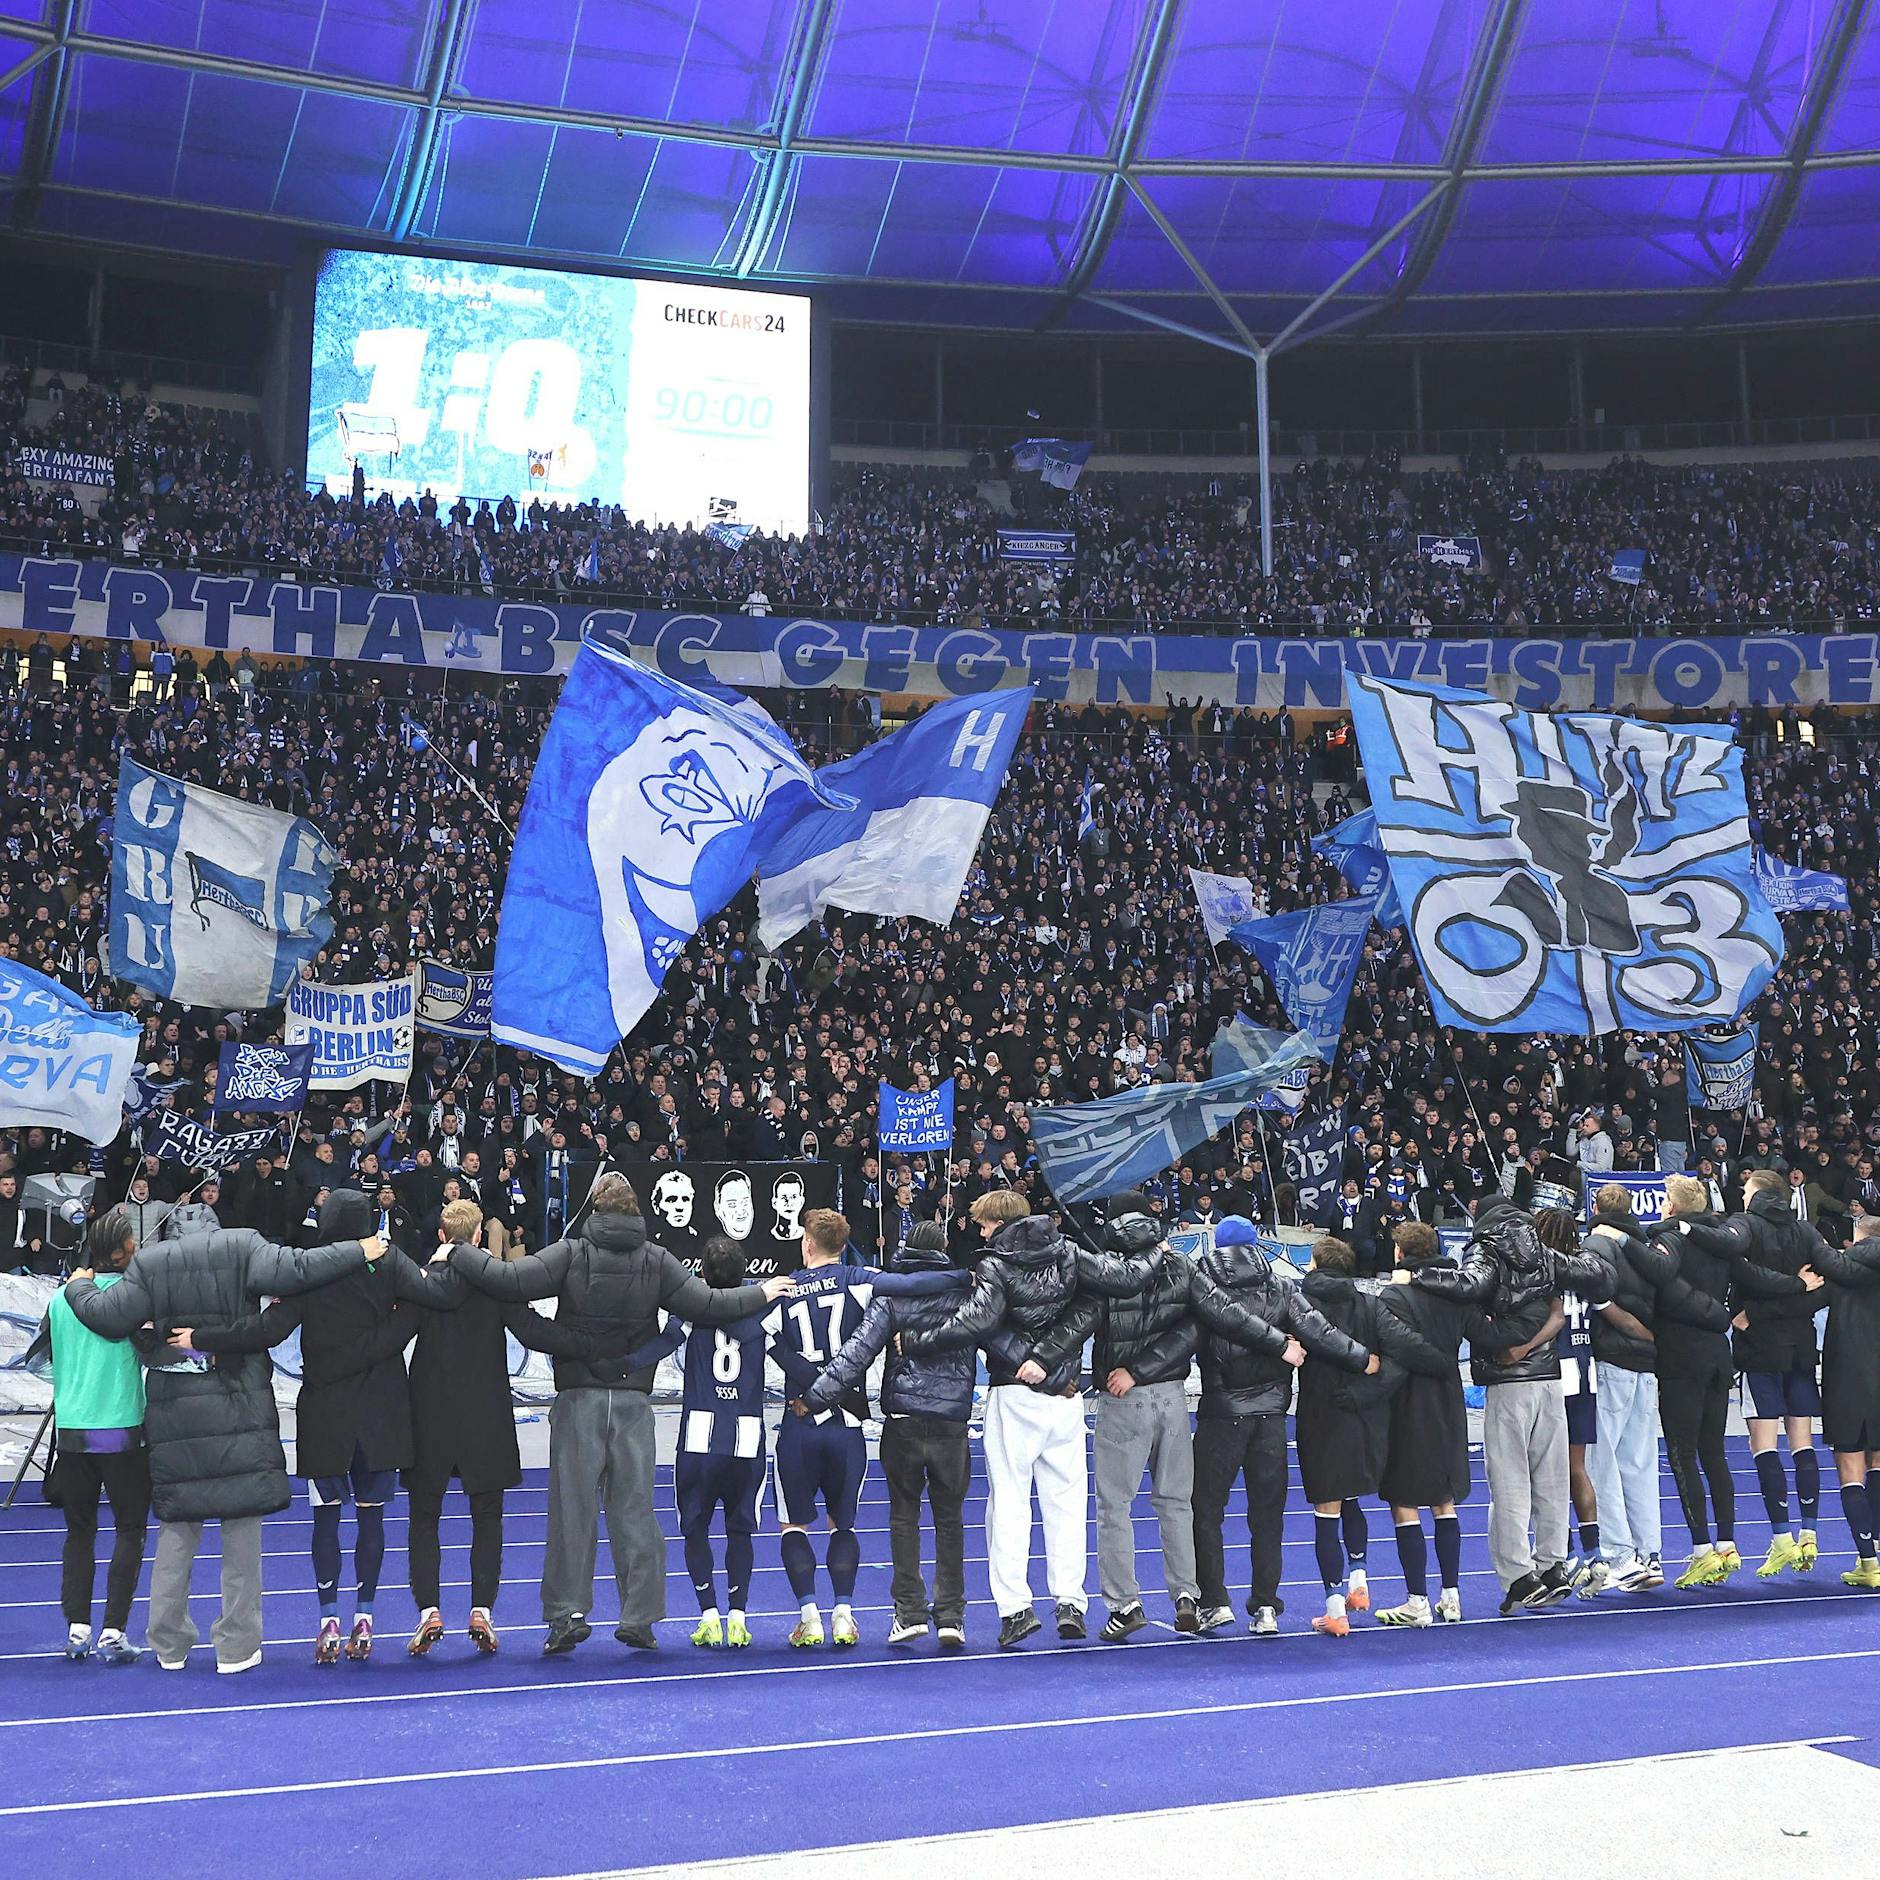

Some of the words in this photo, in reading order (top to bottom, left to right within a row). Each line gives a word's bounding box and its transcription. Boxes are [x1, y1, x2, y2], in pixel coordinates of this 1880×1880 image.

[655, 387, 774, 431] 90:00
[52, 451, 115, 472] AMAZING
[62, 499, 74, 509] 80
[774, 619, 1158, 704] GEGEN
[948, 709, 1007, 772] H
[290, 981, 367, 1026] GRUPPA
[371, 983, 412, 1023] SÜD
[308, 1025, 394, 1062] BERLIN
[395, 1055, 409, 1067] BS
[895, 1089, 940, 1107] UNSER
[897, 1101, 939, 1117] KAMPF
[894, 1117, 920, 1131] IST
[923, 1113, 946, 1129] NIE
[880, 1129, 951, 1146] VERLOREN
[787, 1280, 823, 1300] HERTHA
[821, 1277, 839, 1291] BSC
[788, 1292, 846, 1363] 17
[712, 1327, 742, 1384] 8
[714, 1385, 739, 1401] SESSA
